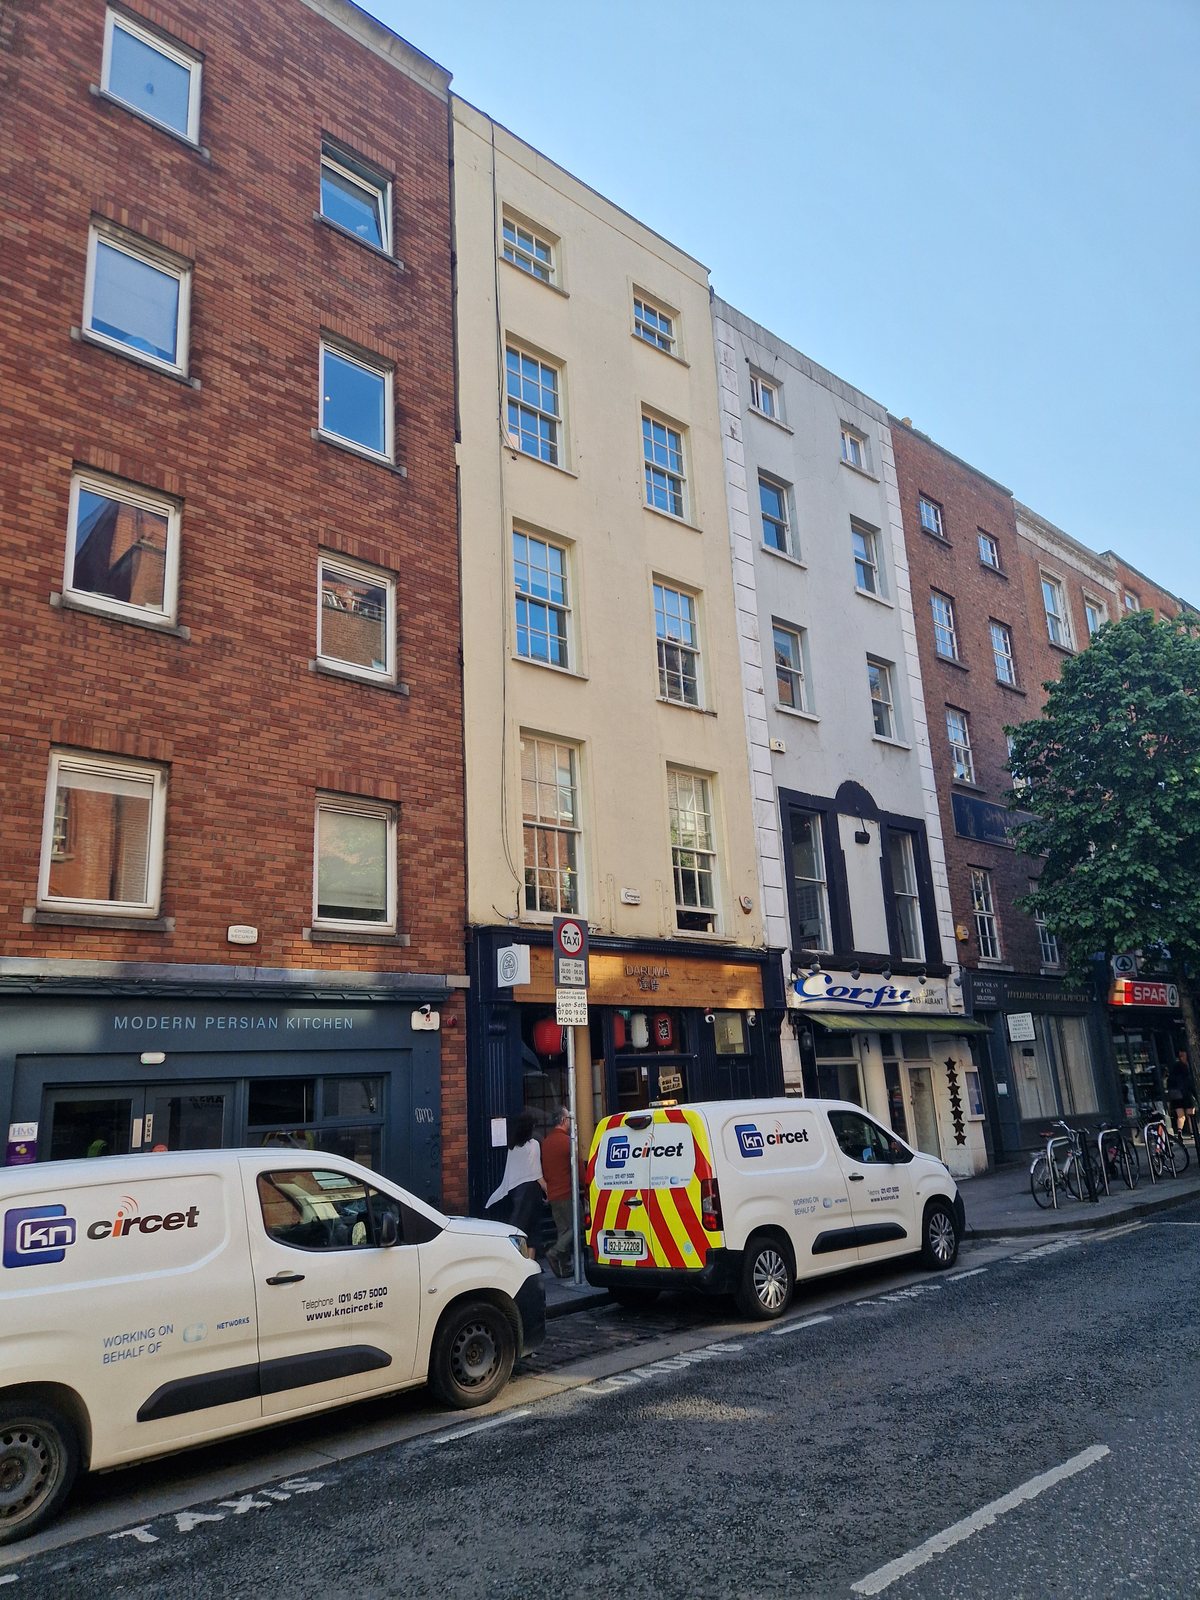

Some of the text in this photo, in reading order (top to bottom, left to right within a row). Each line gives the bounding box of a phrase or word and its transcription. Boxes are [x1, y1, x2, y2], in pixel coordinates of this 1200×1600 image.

[562, 935, 580, 946] TAXI
[626, 965, 670, 977] DARUMA
[794, 971, 912, 1009] Corfu
[1134, 986, 1167, 1002] SPAR
[114, 1016, 354, 1030] MODERN PERSIAN KITCHEN
[12, 1125, 35, 1136] HMS
[743, 1128, 809, 1148] kn circet
[612, 1142, 684, 1159] kn circet
[793, 1197, 813, 1206] WORKING
[794, 1207, 809, 1216] BEHALF
[24, 1206, 200, 1248] kn circet
[302, 1286, 388, 1311] Telephone (01) 457 5000
[306, 1301, 383, 1322] www.kncircet.ie
[216, 1316, 250, 1330] NETWORKS
[103, 1324, 174, 1348] WORKING ON
[103, 1341, 163, 1364] BEHALF OF
[574, 1342, 745, 1394] LOADING
[108, 1476, 326, 1543] TAXIS
